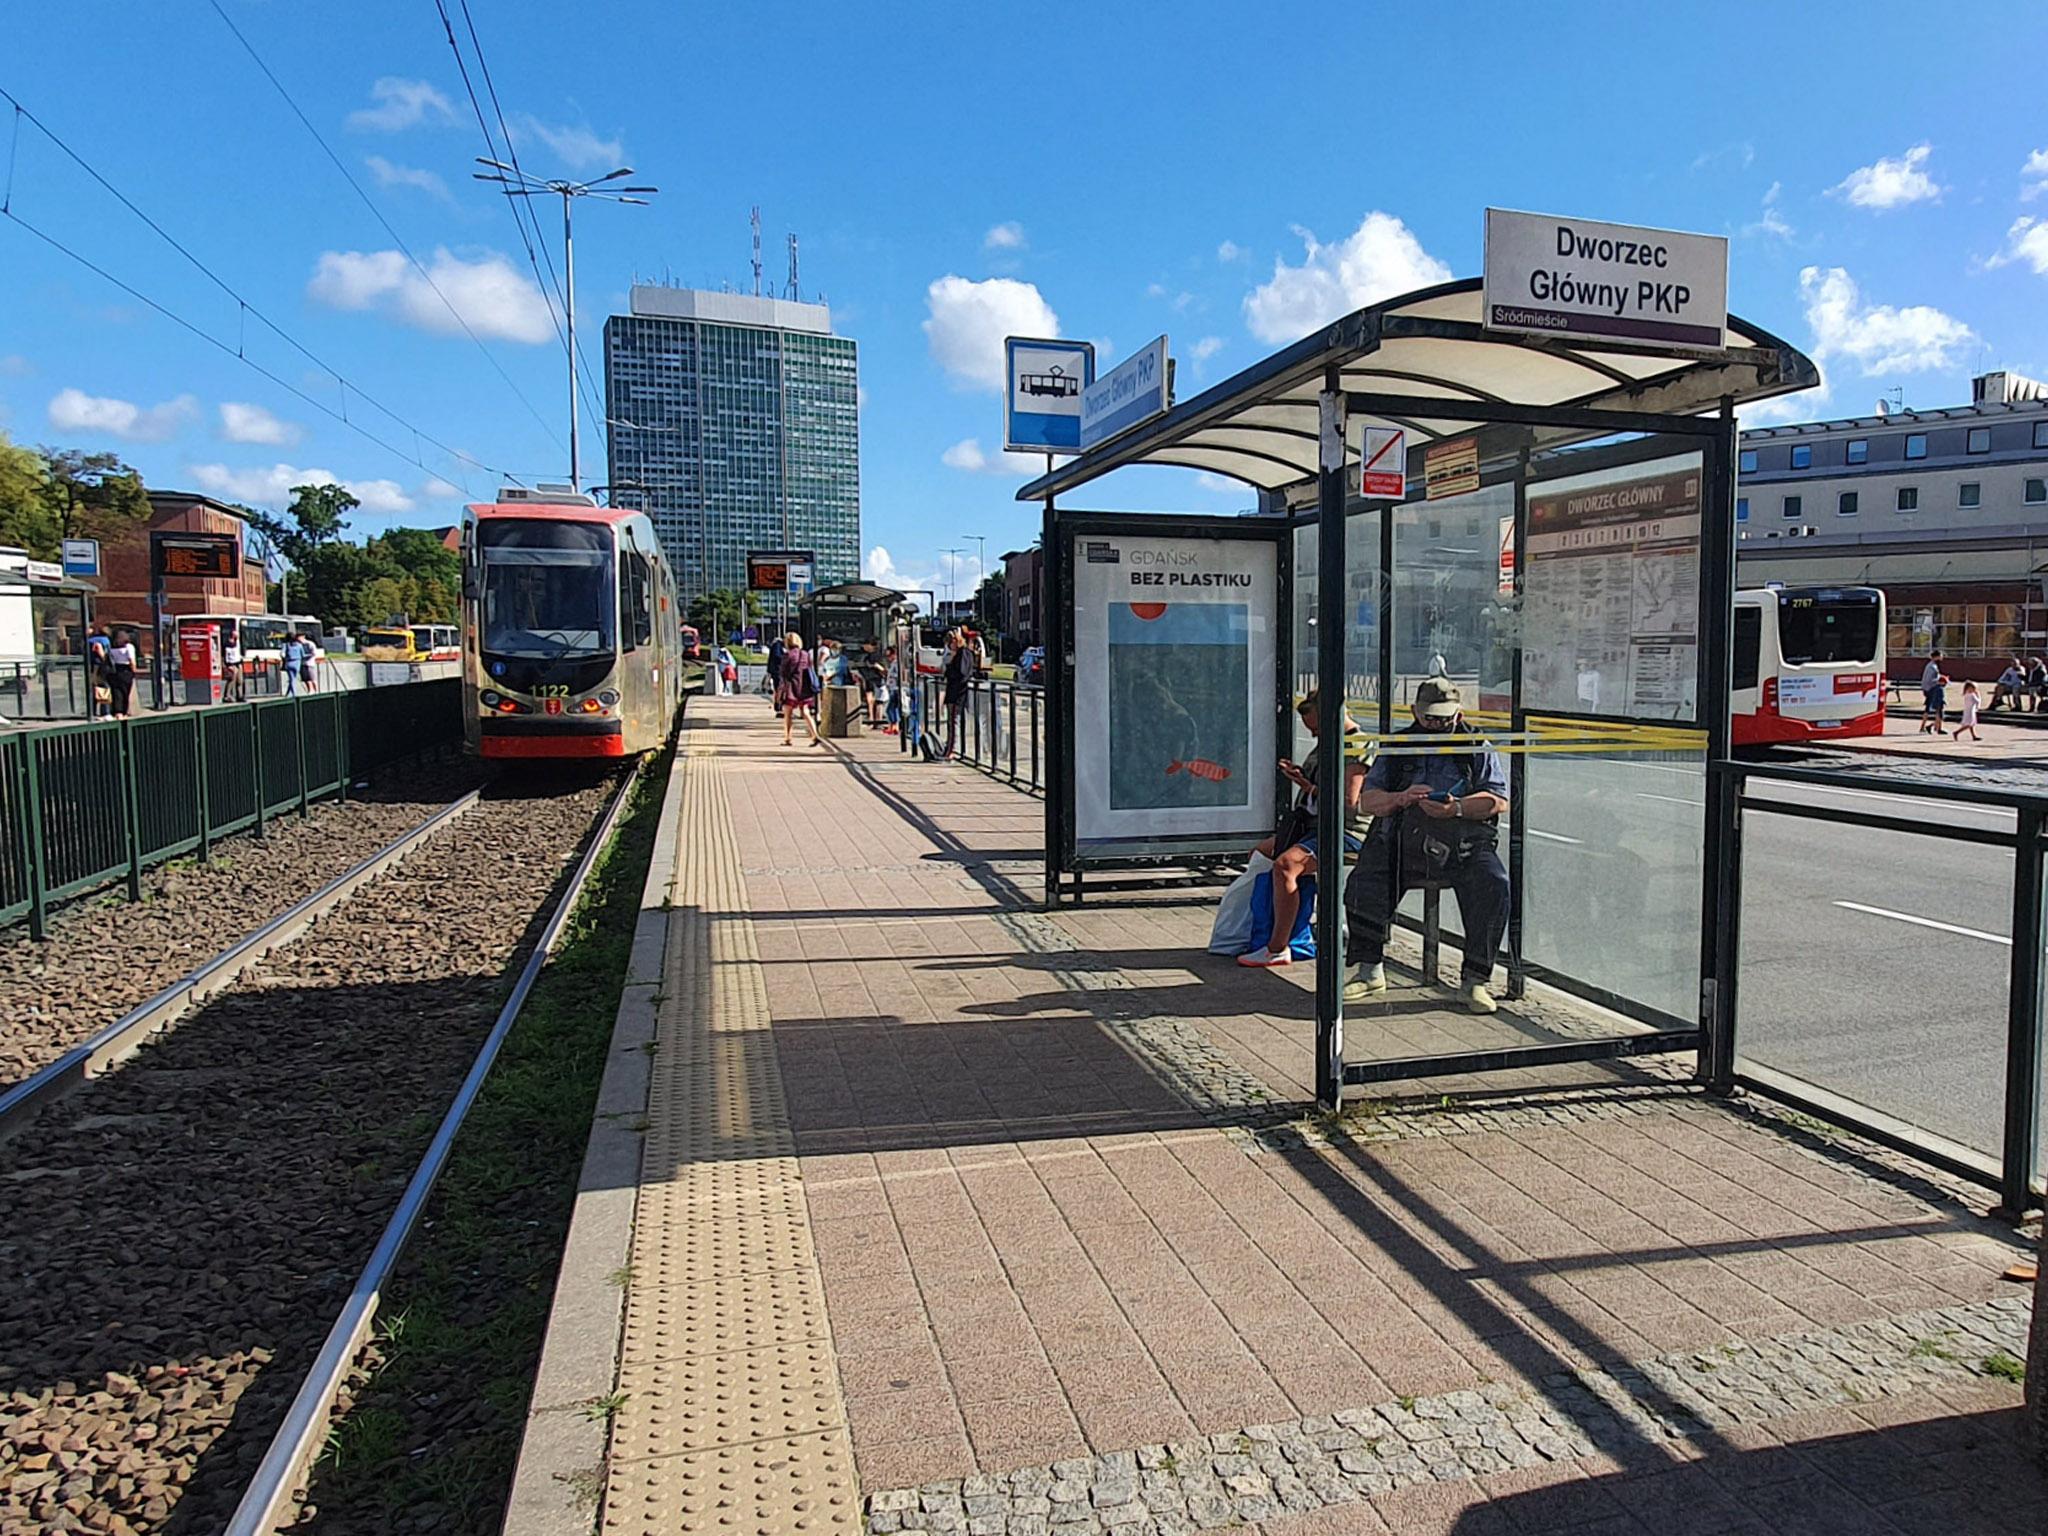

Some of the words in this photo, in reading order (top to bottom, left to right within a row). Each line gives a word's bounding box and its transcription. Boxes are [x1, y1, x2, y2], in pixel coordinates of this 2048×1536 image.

[1556, 226, 1668, 268] Dworzec
[1530, 269, 1629, 315] Główny
[1638, 281, 1691, 315] PKP
[1495, 307, 1568, 328] Śródmieście
[1138, 353, 1154, 385] PKP
[1567, 492, 1617, 515] DWORZEC
[1617, 485, 1665, 507] GŁÓWNY
[1129, 548, 1199, 566] GDAŃSK
[1131, 572, 1164, 586] BEZ
[1169, 573, 1252, 587] PLASTIKU
[528, 684, 570, 698] 1122
